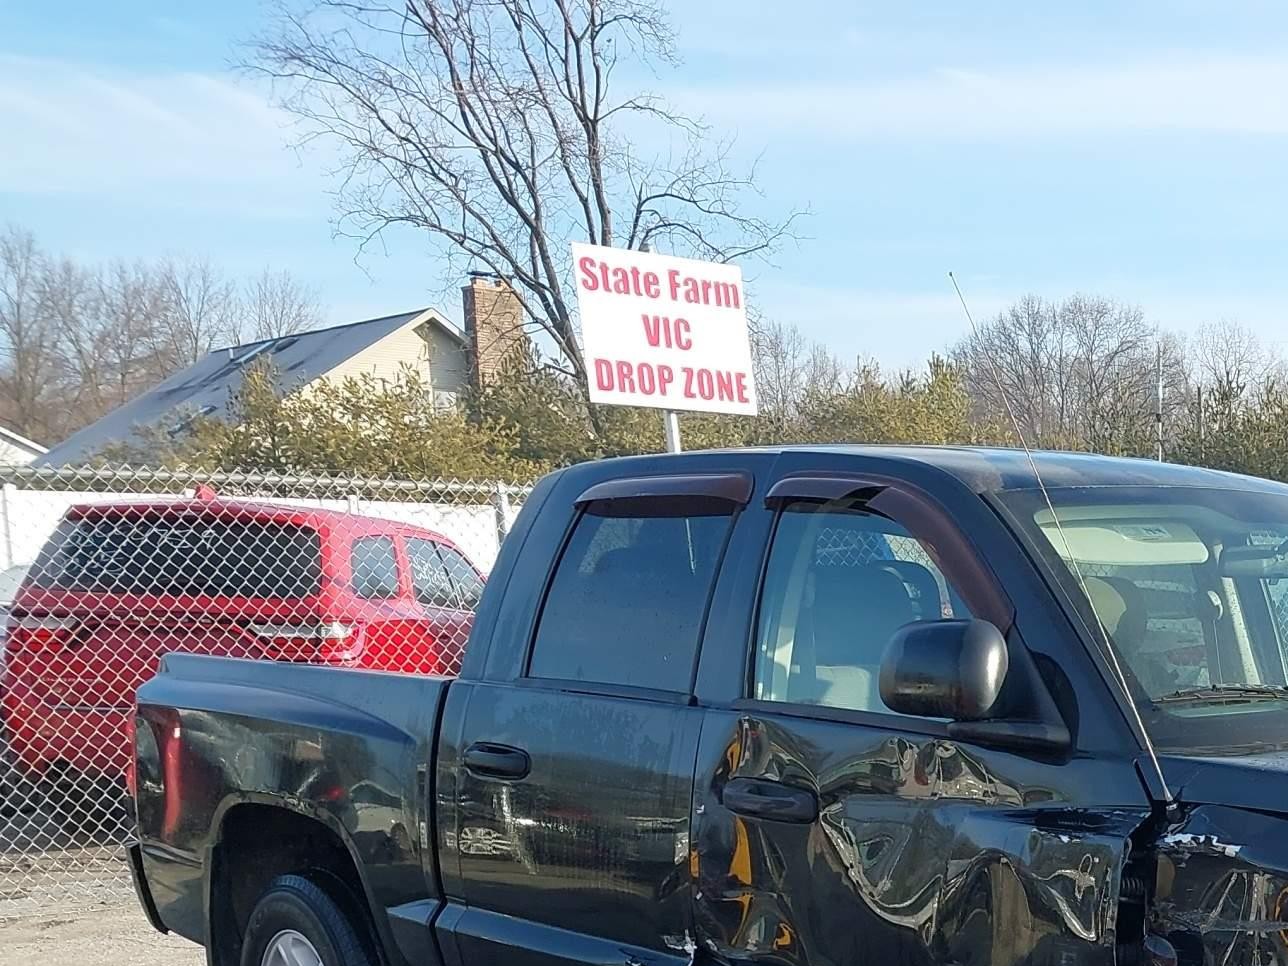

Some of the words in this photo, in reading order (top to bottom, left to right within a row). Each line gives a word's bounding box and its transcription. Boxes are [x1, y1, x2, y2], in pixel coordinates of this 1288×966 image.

[579, 256, 661, 299] State
[667, 269, 741, 309] Farm
[641, 314, 693, 351] VIC
[594, 358, 674, 396] DROP
[681, 367, 750, 404] ZONE
